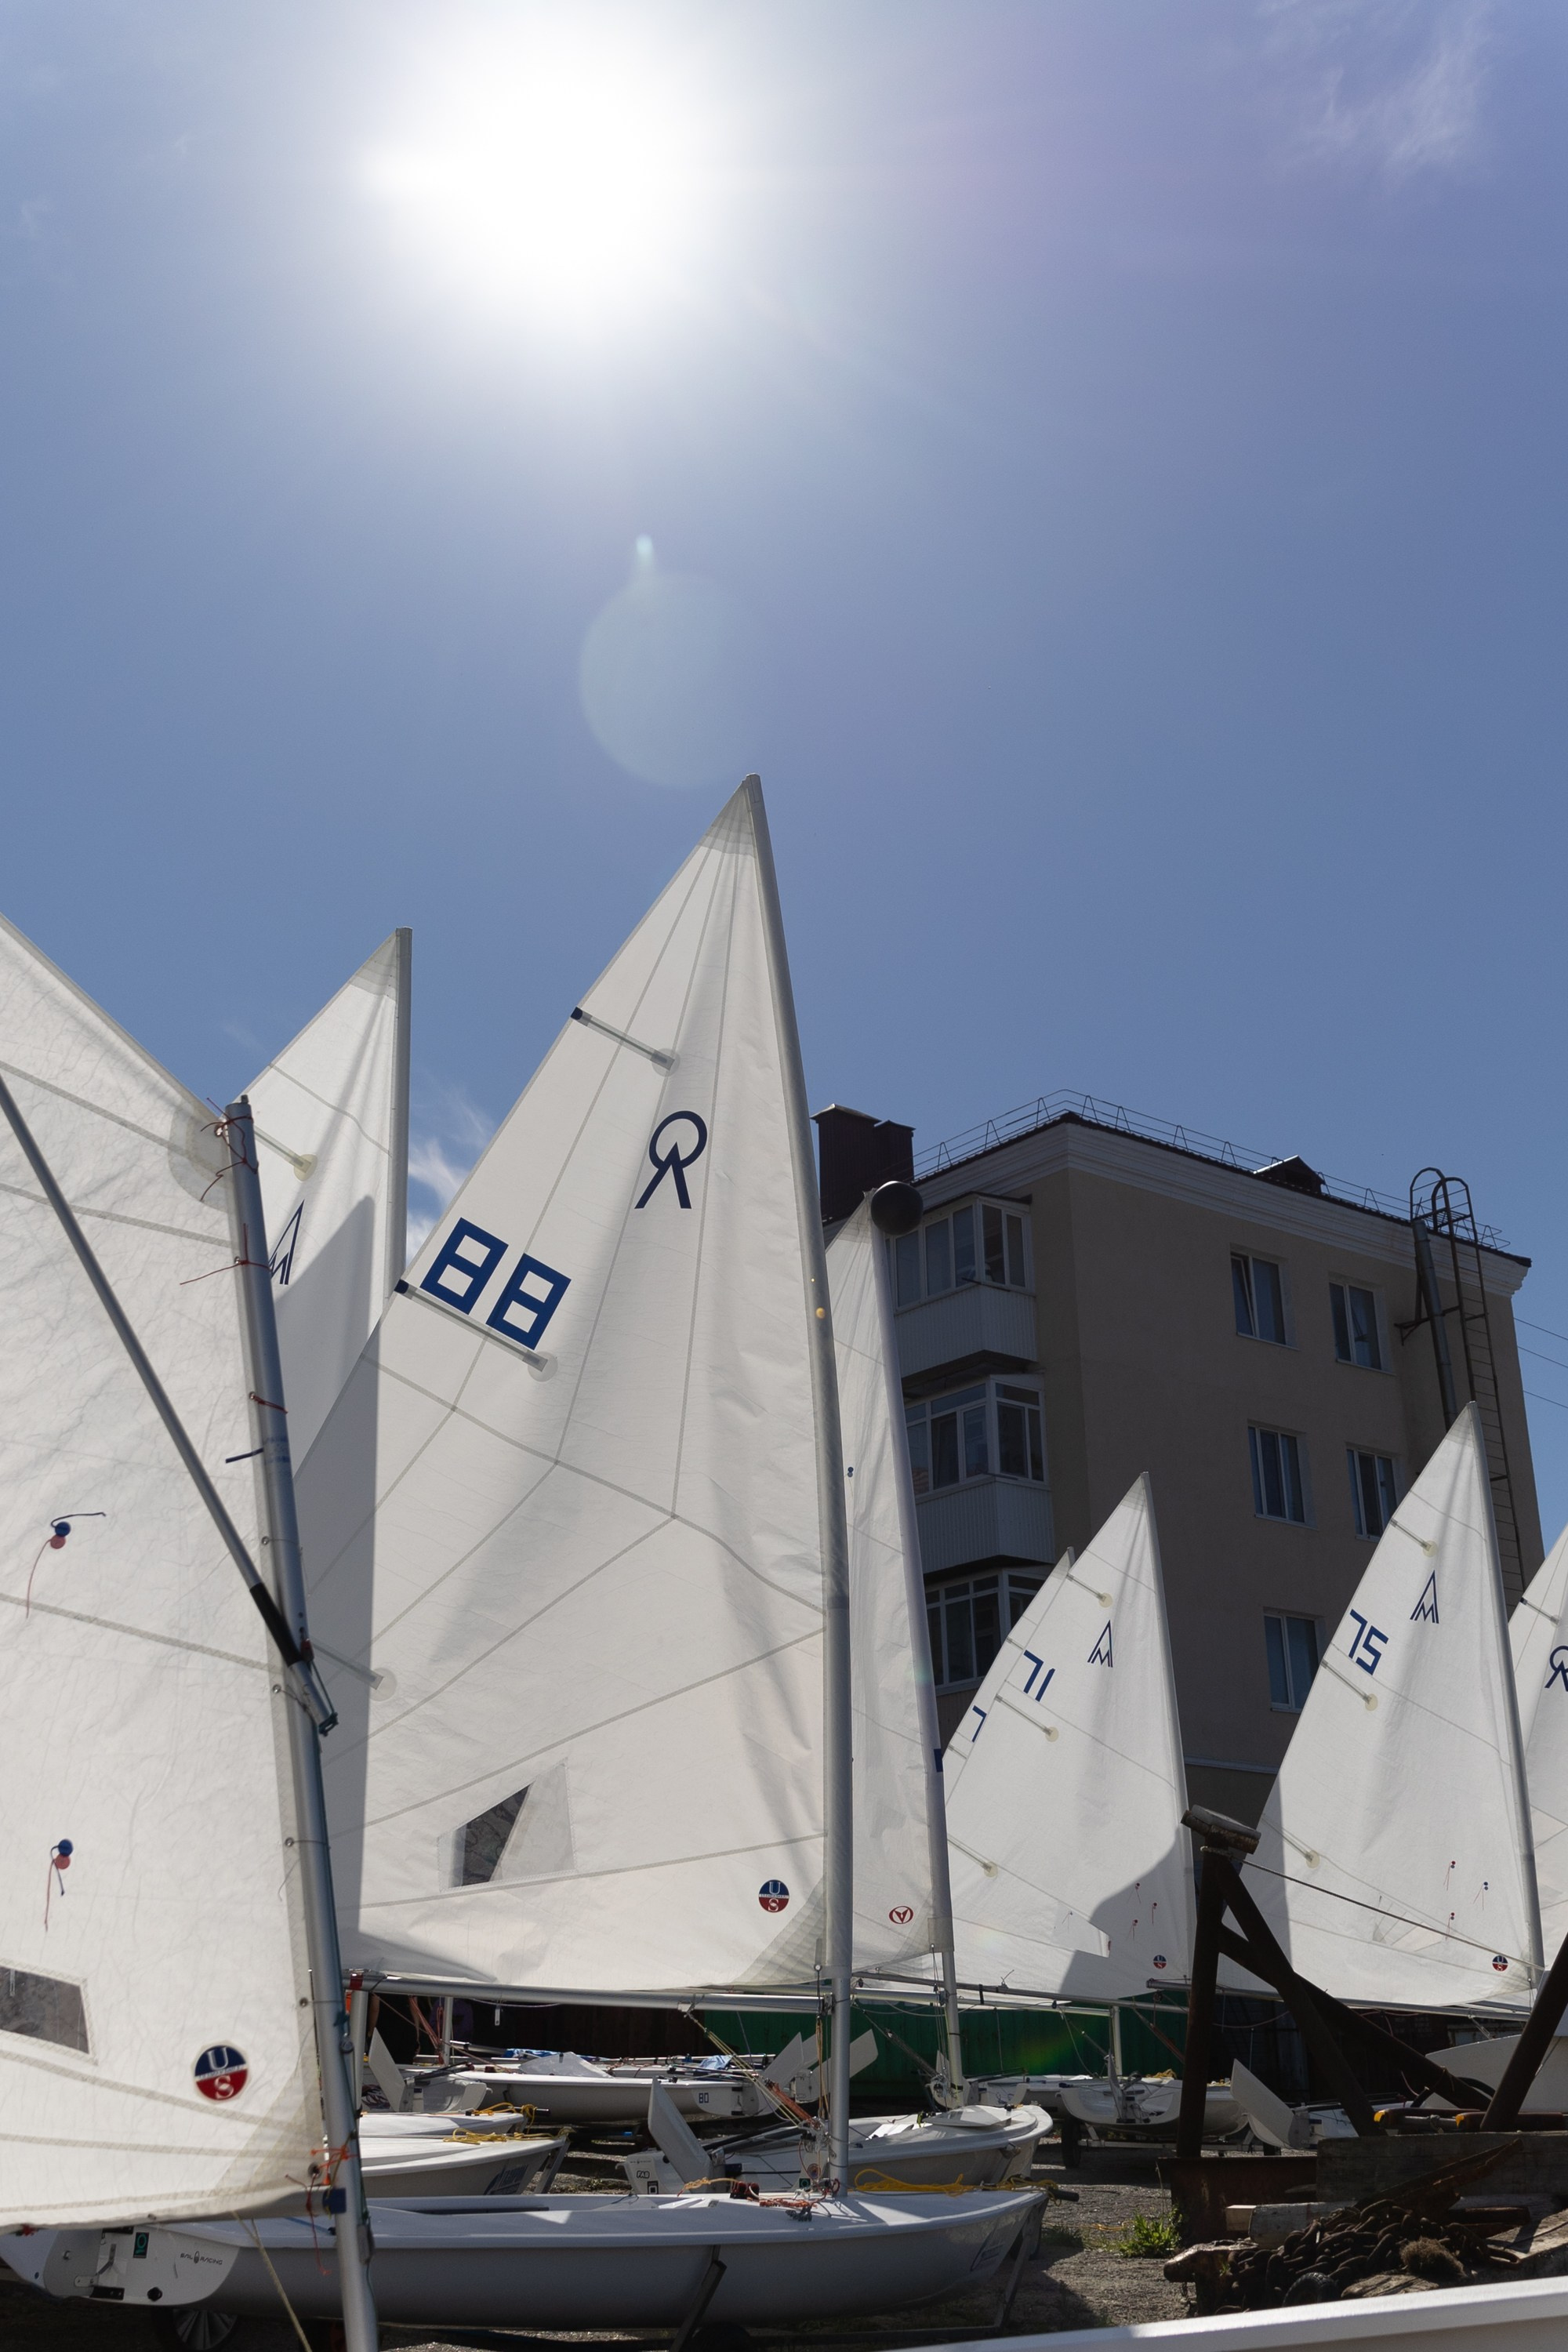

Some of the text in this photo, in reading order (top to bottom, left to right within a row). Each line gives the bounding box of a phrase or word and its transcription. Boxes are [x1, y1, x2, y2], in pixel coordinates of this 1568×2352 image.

[419, 1217, 572, 1351] 88
[1348, 1609, 1389, 1676] 75
[1023, 1650, 1056, 1702] 71
[200, 2256, 223, 2266] RACING
